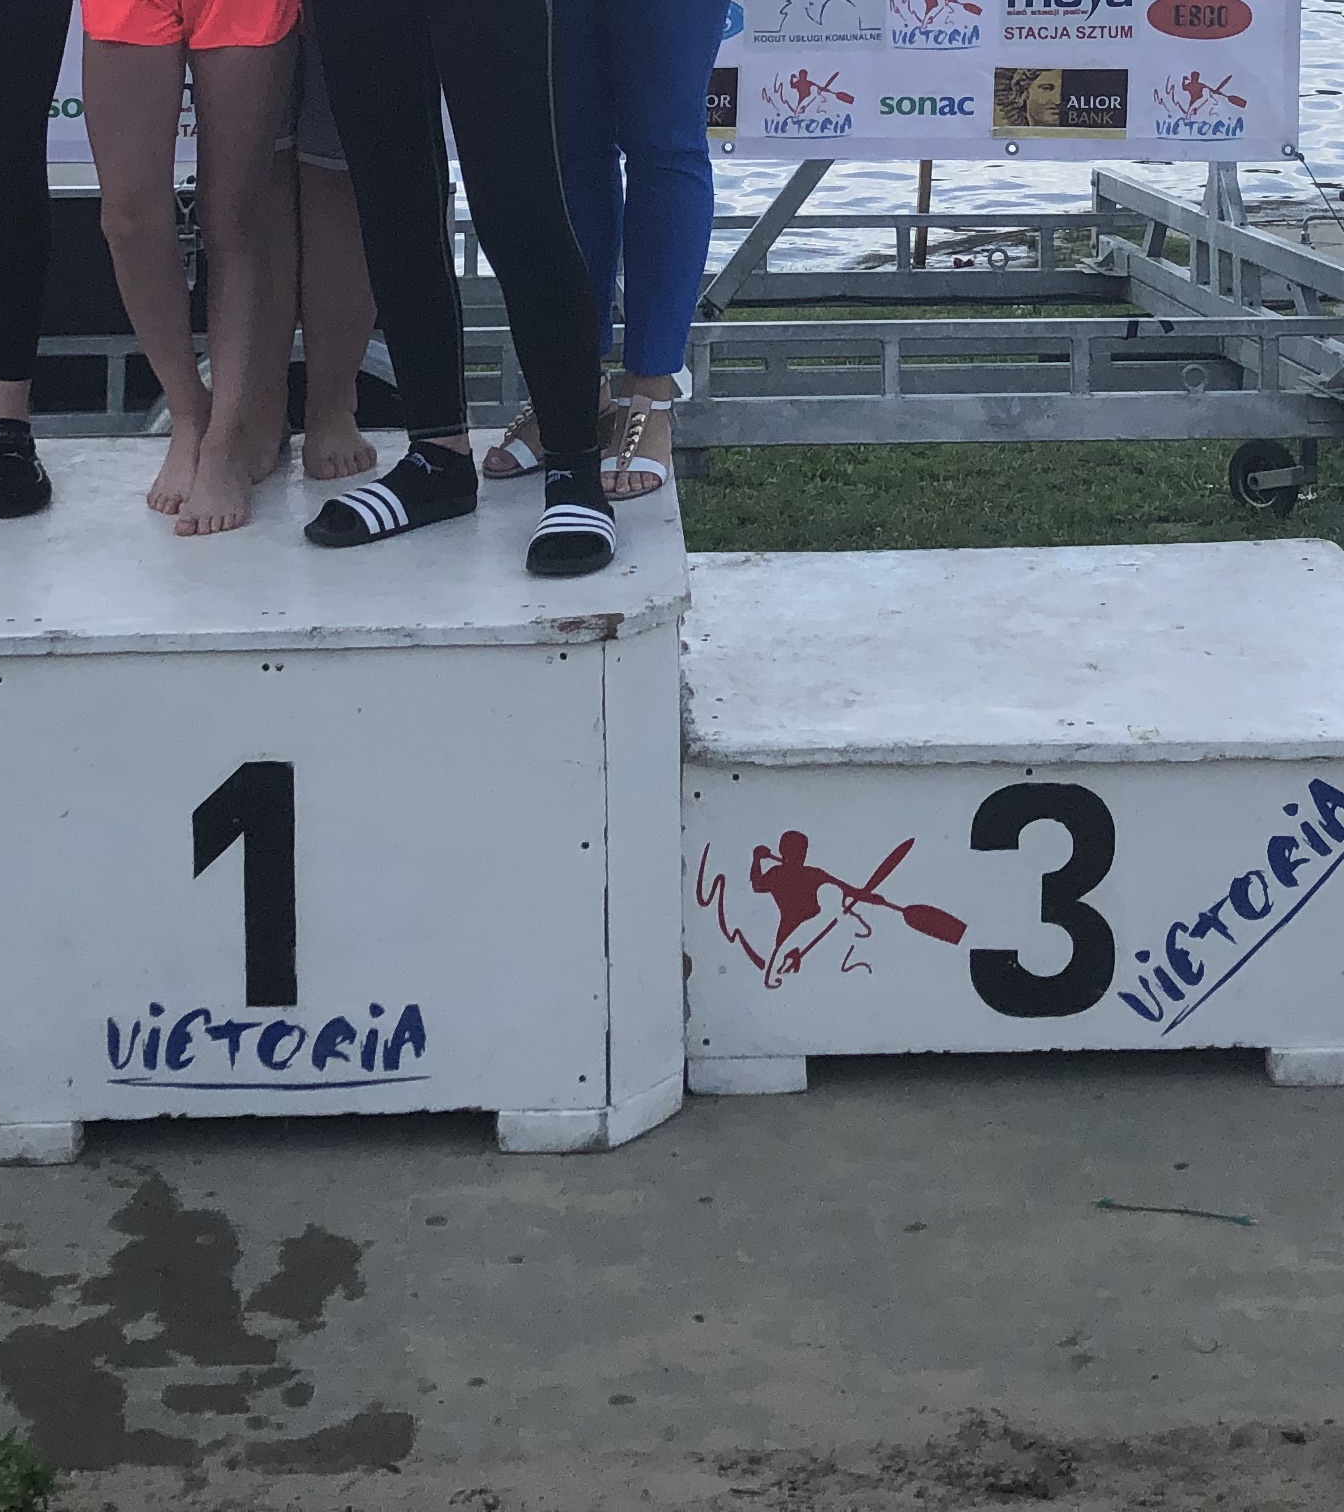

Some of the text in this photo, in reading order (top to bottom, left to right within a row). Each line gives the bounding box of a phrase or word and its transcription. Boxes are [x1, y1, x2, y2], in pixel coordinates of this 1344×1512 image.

[754, 34, 787, 43] KOGUT
[825, 31, 882, 43] KOMUNALNE
[1004, 25, 1134, 40] STACJA SZTUM
[879, 95, 975, 117] sonac
[1066, 94, 1123, 110] ALIOR
[1067, 111, 1115, 125] BANK
[192, 760, 298, 1008] 1
[968, 782, 1117, 1019] 3
